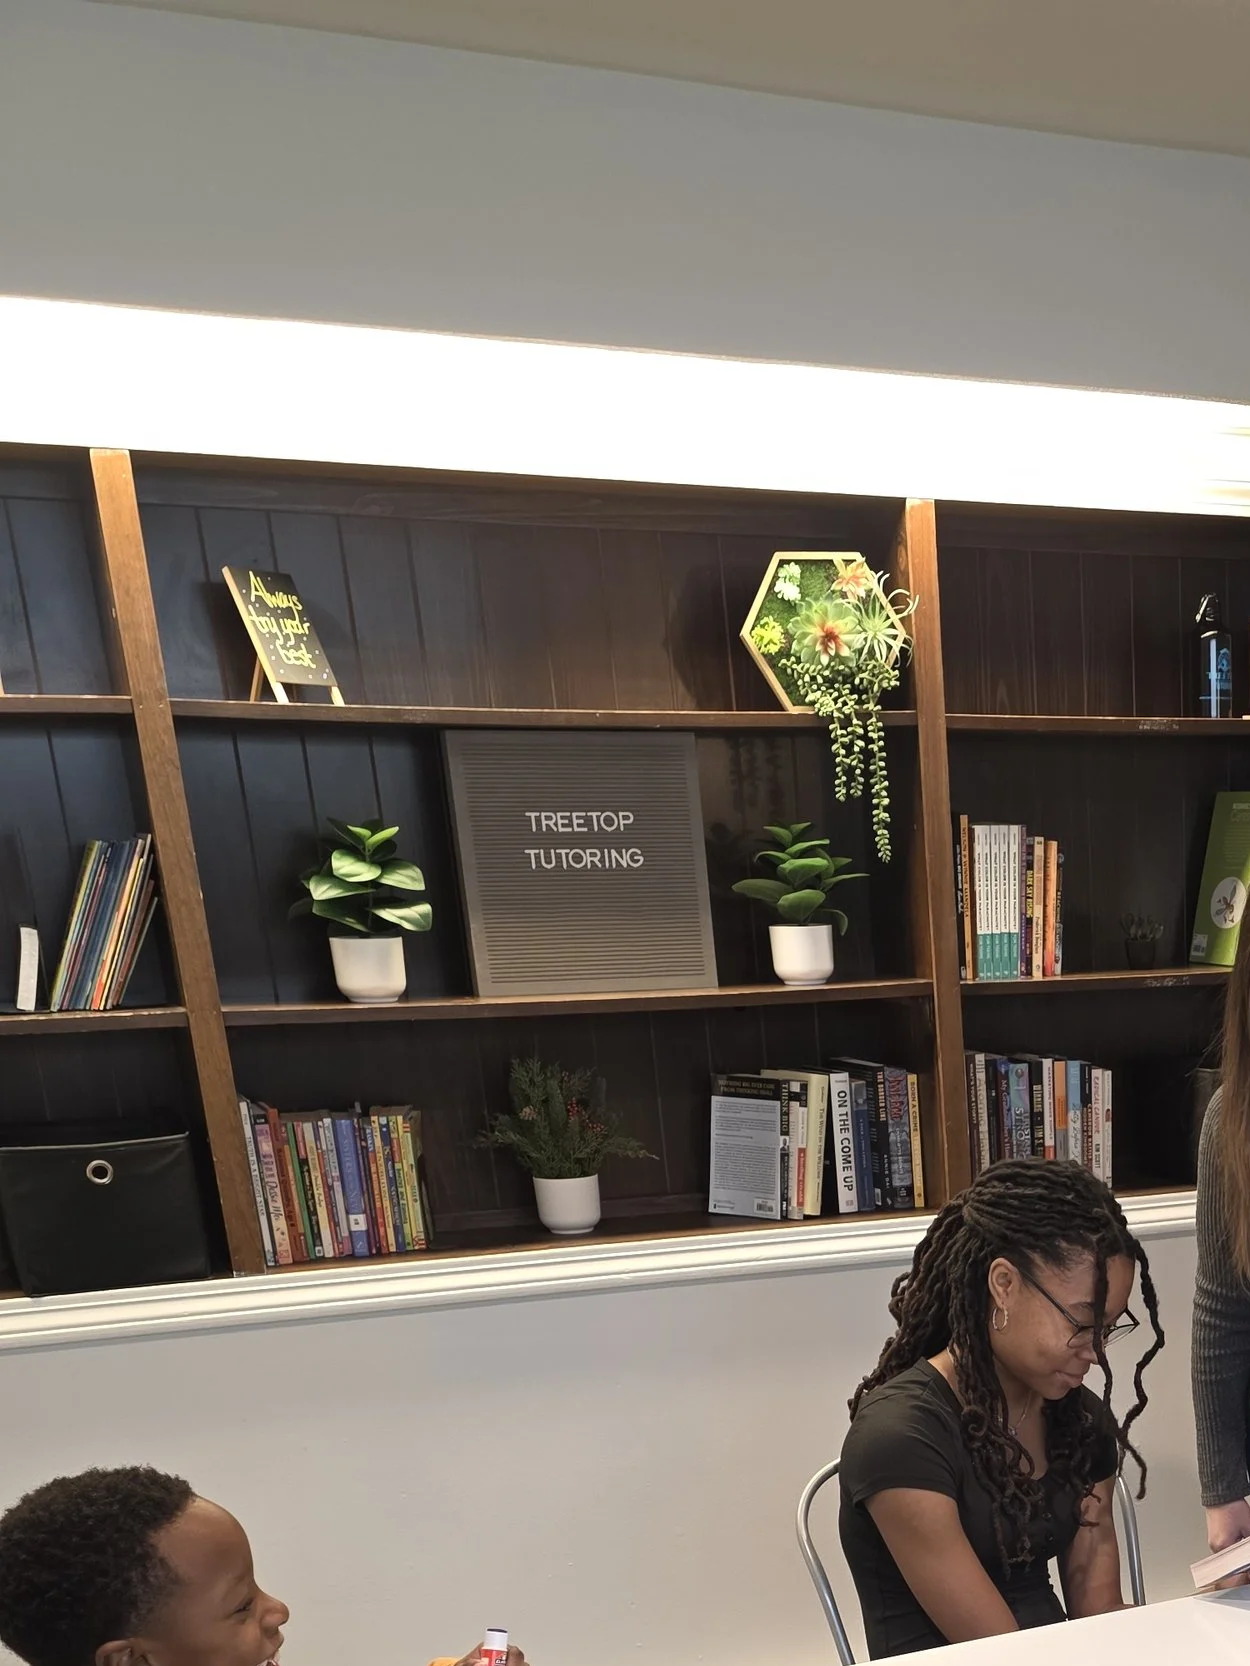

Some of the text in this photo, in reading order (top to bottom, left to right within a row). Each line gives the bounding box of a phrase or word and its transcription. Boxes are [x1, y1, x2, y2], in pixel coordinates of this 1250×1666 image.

[248, 570, 303, 622] Always
[247, 604, 310, 648] try your
[275, 639, 317, 669] best
[525, 811, 634, 832] TREETOP
[524, 848, 644, 870] TUTORING
[781, 1083, 789, 1132] THINK BIG
[837, 1090, 847, 1108] ON
[838, 1111, 850, 1134] THE
[840, 1137, 852, 1172] COME
[842, 1175, 854, 1192] UP
